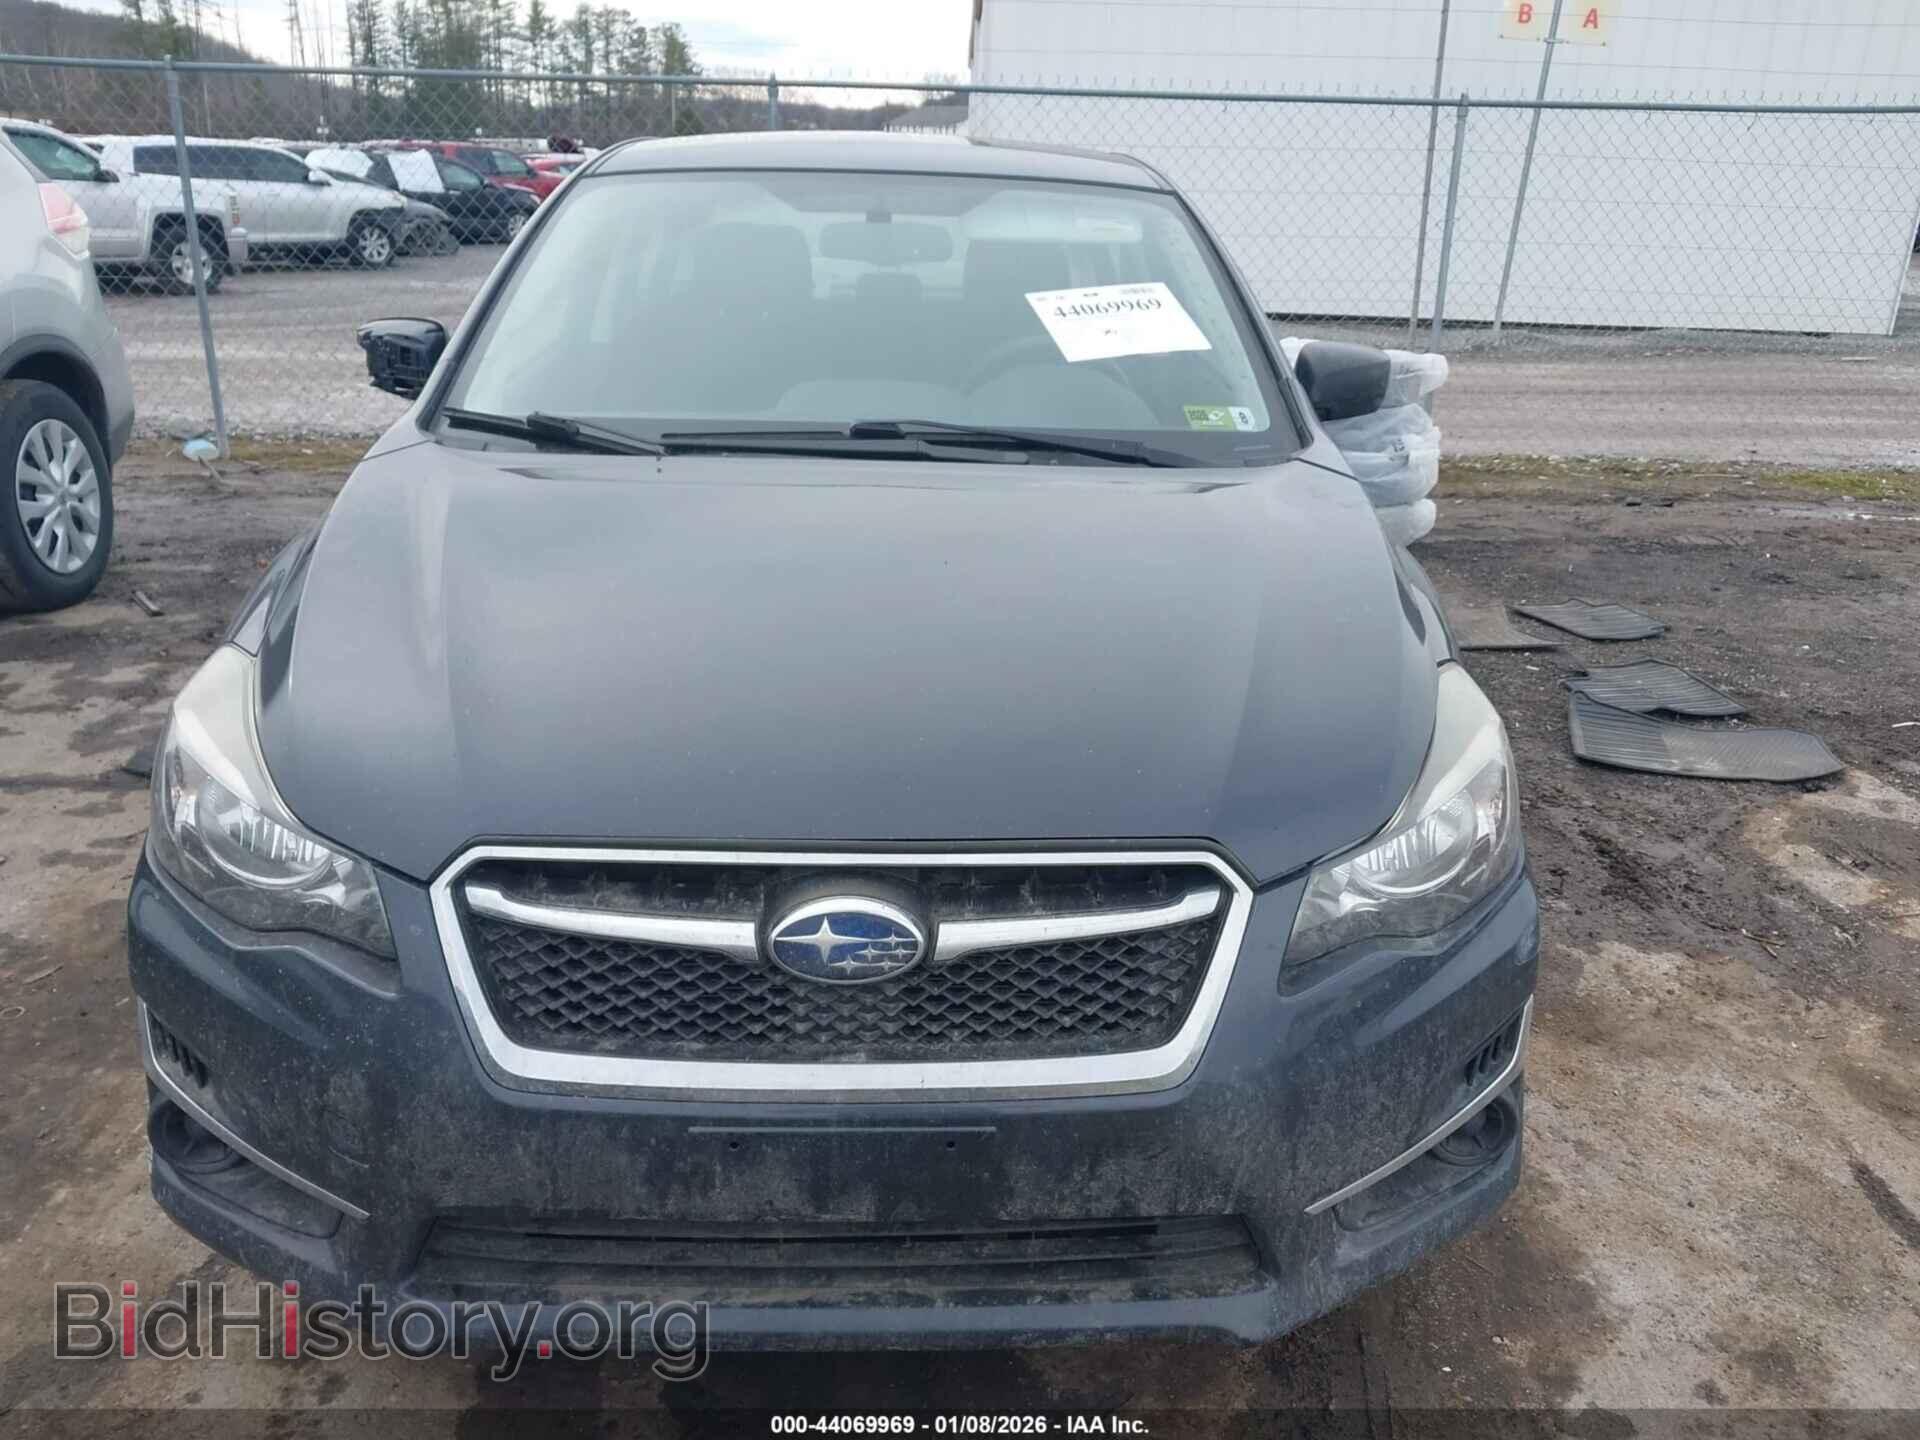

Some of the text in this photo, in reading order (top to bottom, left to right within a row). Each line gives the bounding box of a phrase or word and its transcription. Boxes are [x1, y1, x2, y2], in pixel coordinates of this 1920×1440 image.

[1517, 3, 1533, 24] B
[1582, 8, 1599, 29] A
[1054, 298, 1162, 318] 44069969
